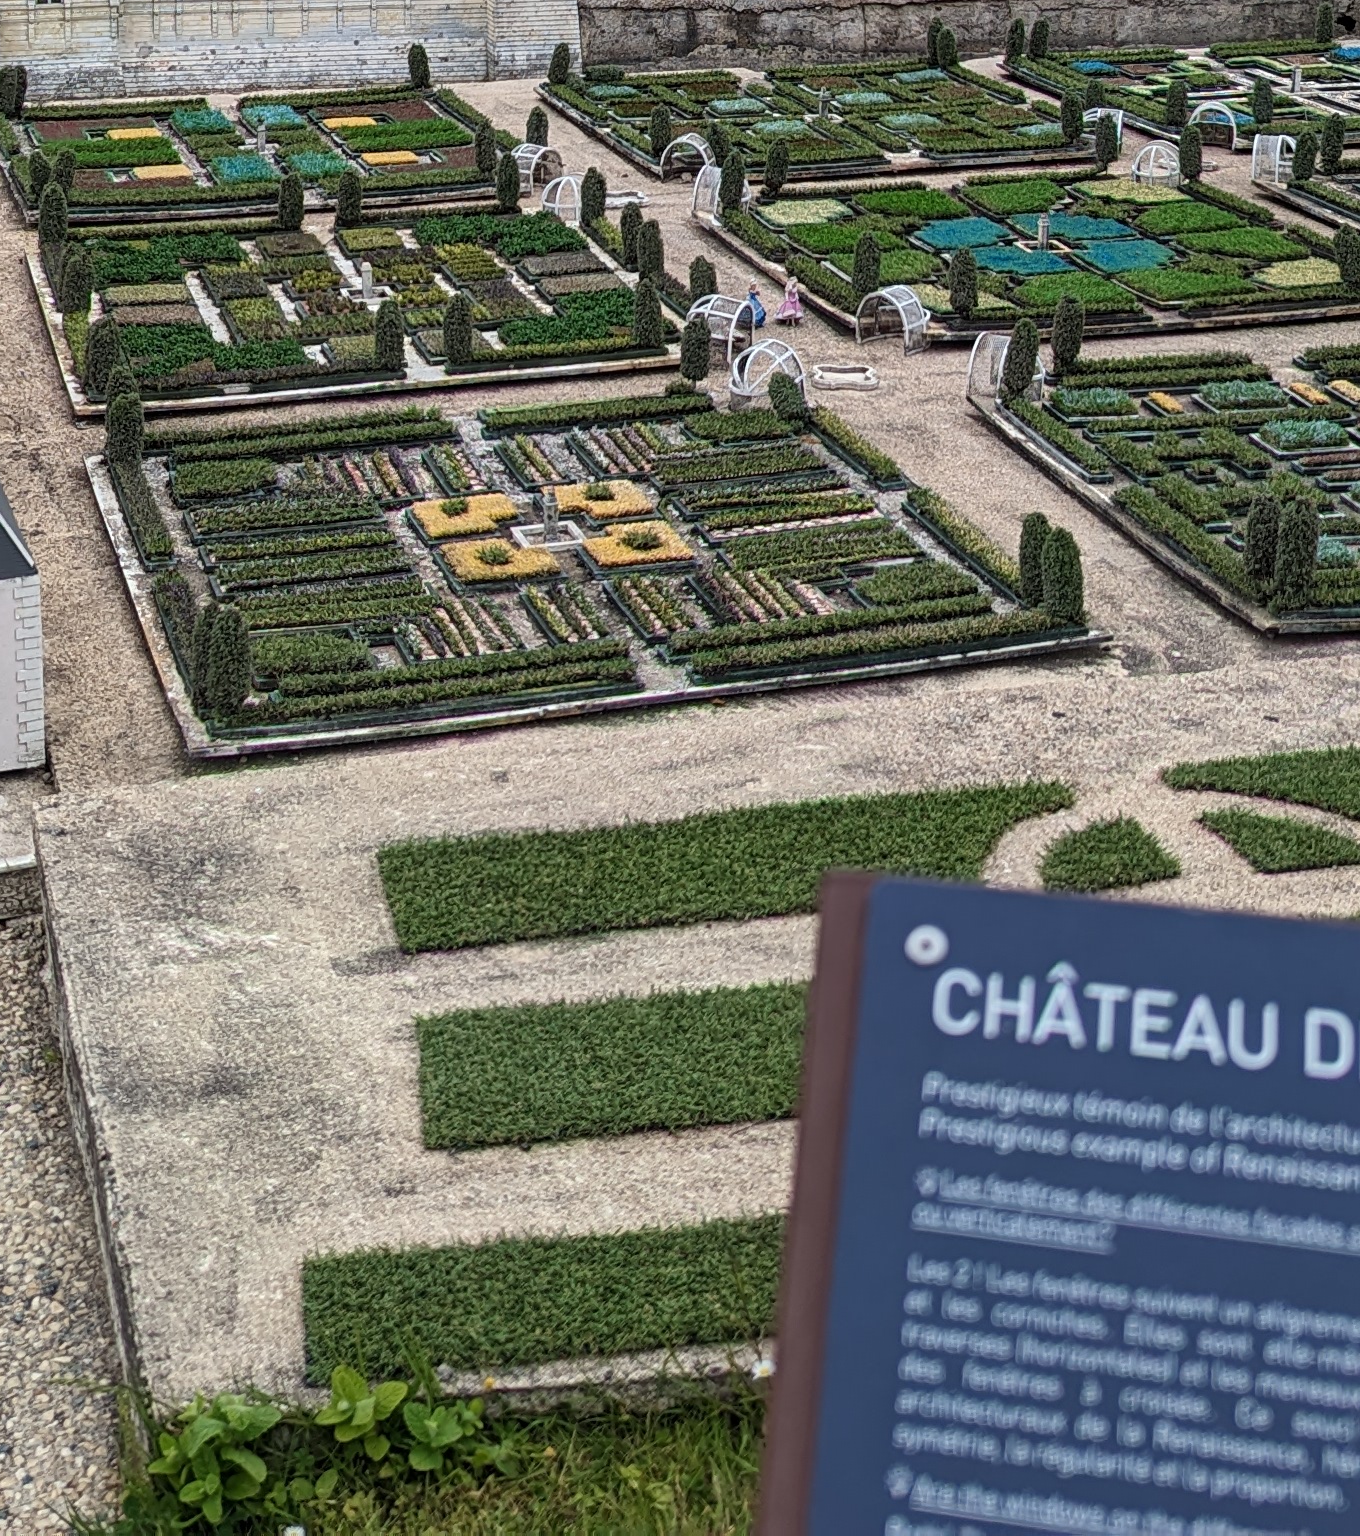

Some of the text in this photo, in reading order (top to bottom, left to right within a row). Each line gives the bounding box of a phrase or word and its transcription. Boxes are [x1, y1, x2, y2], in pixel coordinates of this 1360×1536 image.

[932, 961, 1281, 1071] CHÂTEAU
[921, 1070, 1071, 1119] Prestigieux
[1073, 1089, 1169, 1130] témoin
[1170, 1102, 1208, 1135] de
[918, 1107, 1071, 1155] Prestigious
[1071, 1131, 1189, 1171] example
[1190, 1141, 1223, 1174] of
